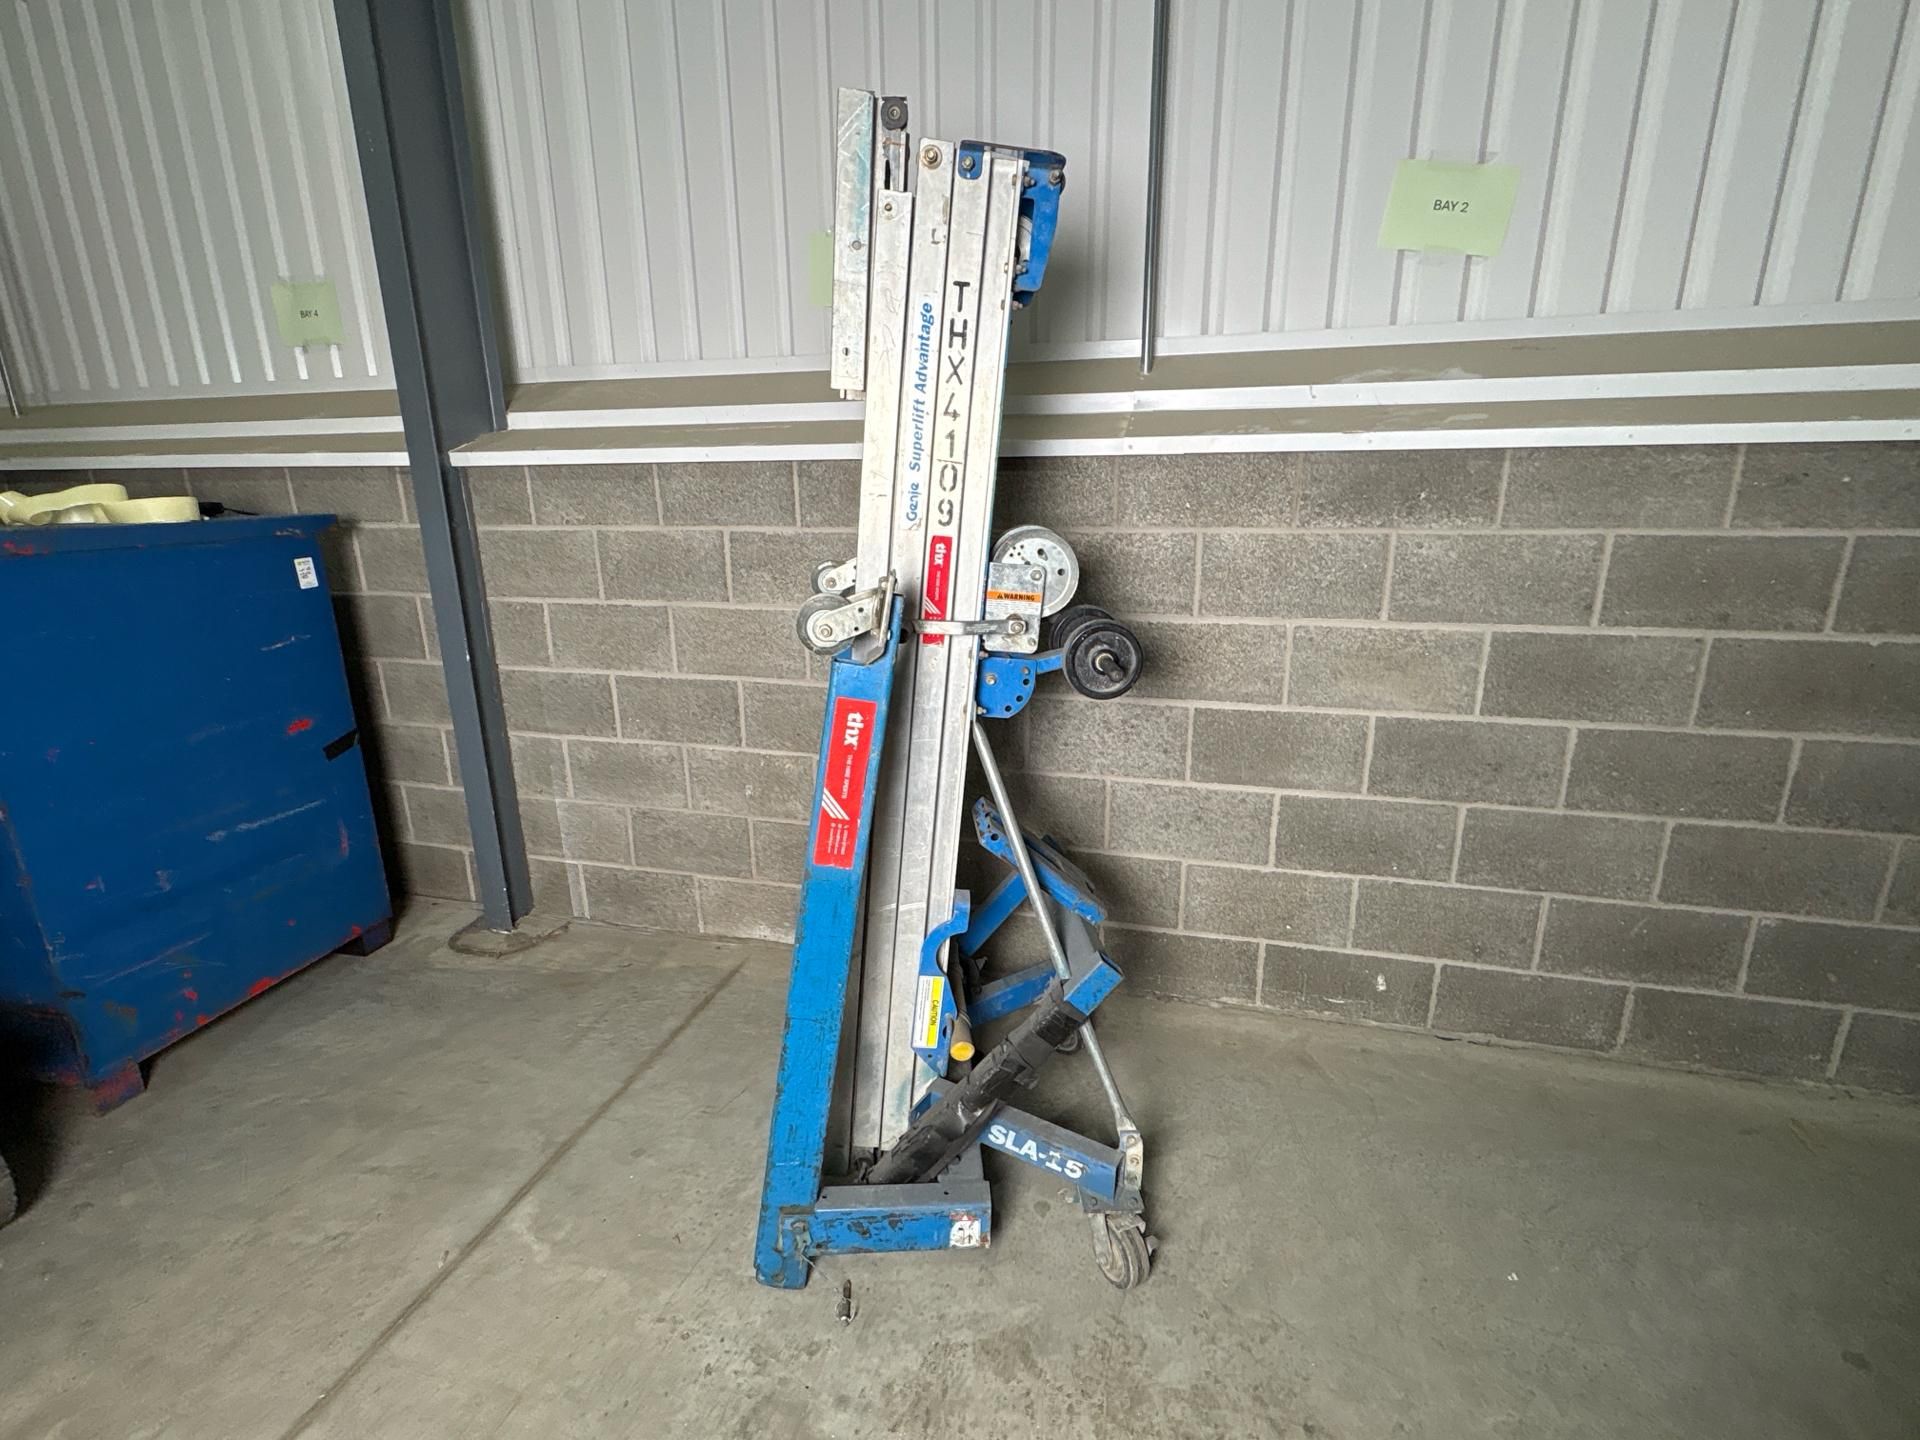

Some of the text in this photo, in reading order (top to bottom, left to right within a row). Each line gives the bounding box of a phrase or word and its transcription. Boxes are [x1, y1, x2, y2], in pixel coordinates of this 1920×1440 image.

[1433, 199, 1469, 213] BAY 2
[300, 310, 312, 318] BAY
[906, 302, 934, 522] Genie Superlift Advantage
[935, 543, 947, 567] thx
[1003, 592, 1035, 601] WARNING
[844, 712, 864, 748] thx
[930, 1000, 939, 1025] CAUTION
